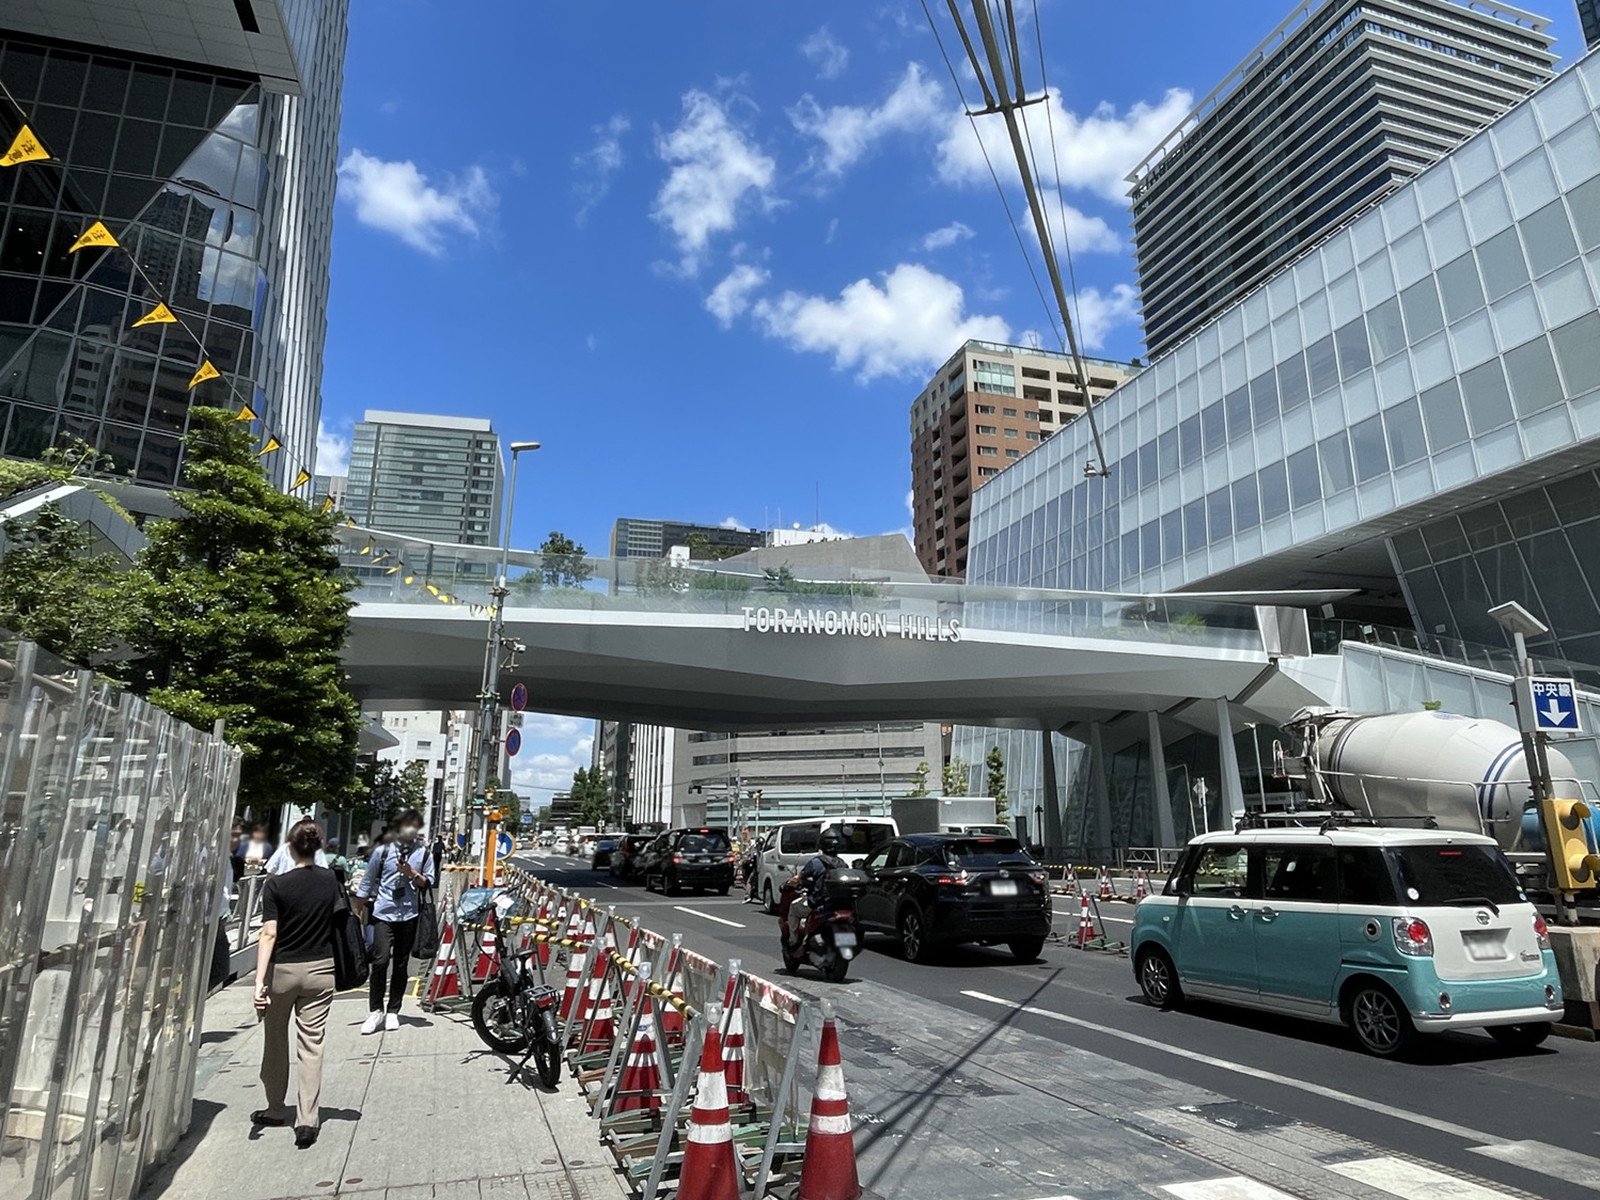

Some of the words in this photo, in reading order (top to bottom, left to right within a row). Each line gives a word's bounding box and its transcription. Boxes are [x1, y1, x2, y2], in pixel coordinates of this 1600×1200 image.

[741, 606, 888, 638] TORANOMON
[900, 614, 962, 643] HILLS
[1533, 682, 1571, 696] 中央線
